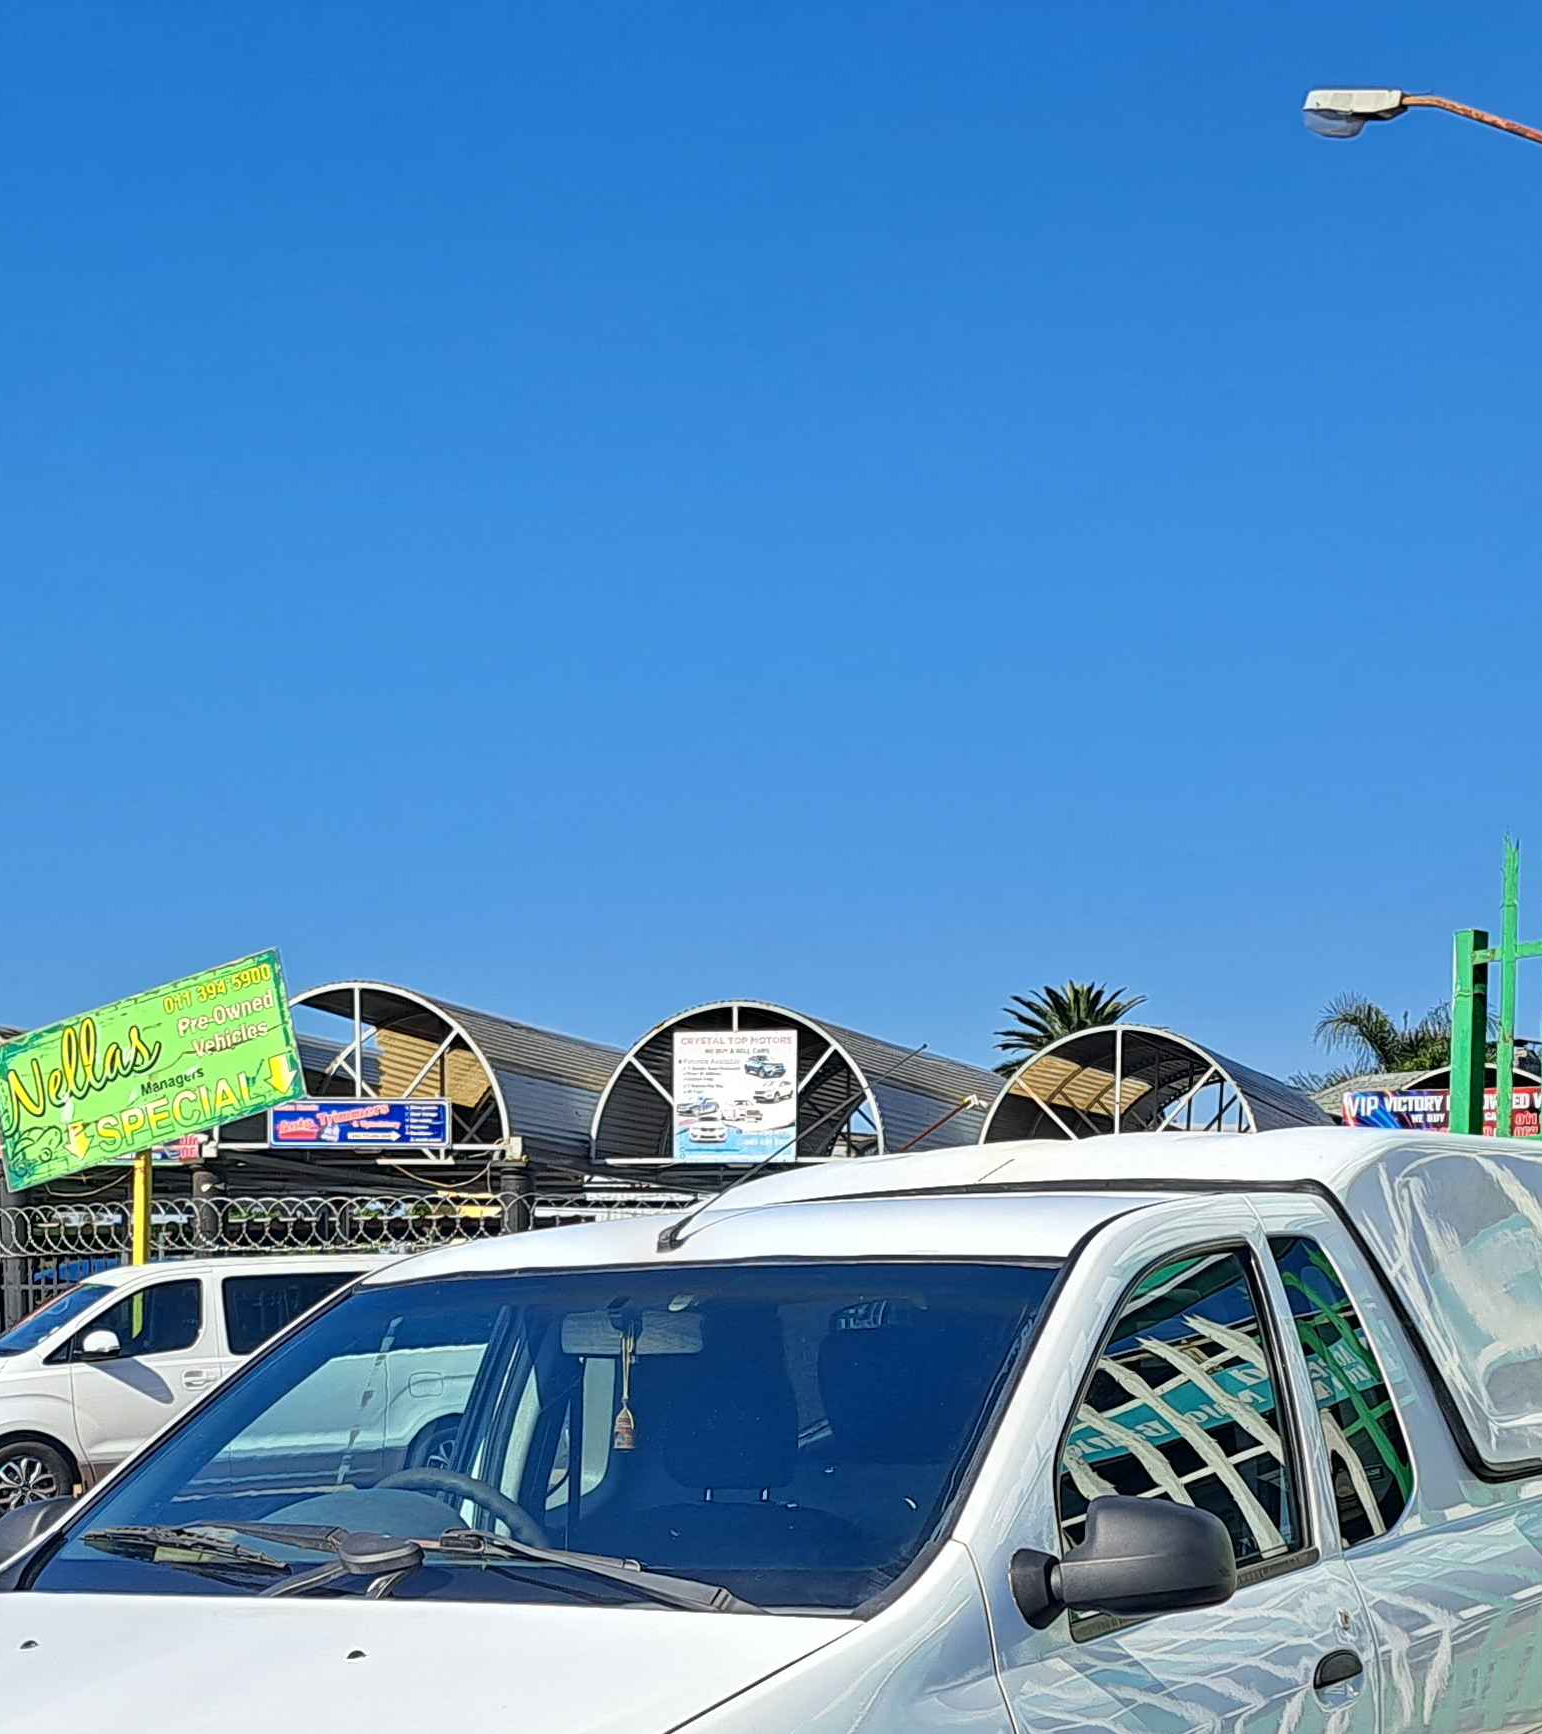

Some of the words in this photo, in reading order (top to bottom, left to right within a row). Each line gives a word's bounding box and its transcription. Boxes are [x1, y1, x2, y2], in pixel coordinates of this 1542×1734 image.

[176, 989, 275, 1037] Pre-Owned
[192, 1019, 269, 1058] Vehicles
[728, 1036, 749, 1045] TOP
[750, 1036, 793, 1045] MOTORS
[4, 1016, 162, 1138] Nellas
[140, 1067, 205, 1097] Managers
[94, 1069, 265, 1153] SPECIAL
[1383, 1095, 1444, 1112] VICTORY
[1426, 1113, 1445, 1123] BUY
